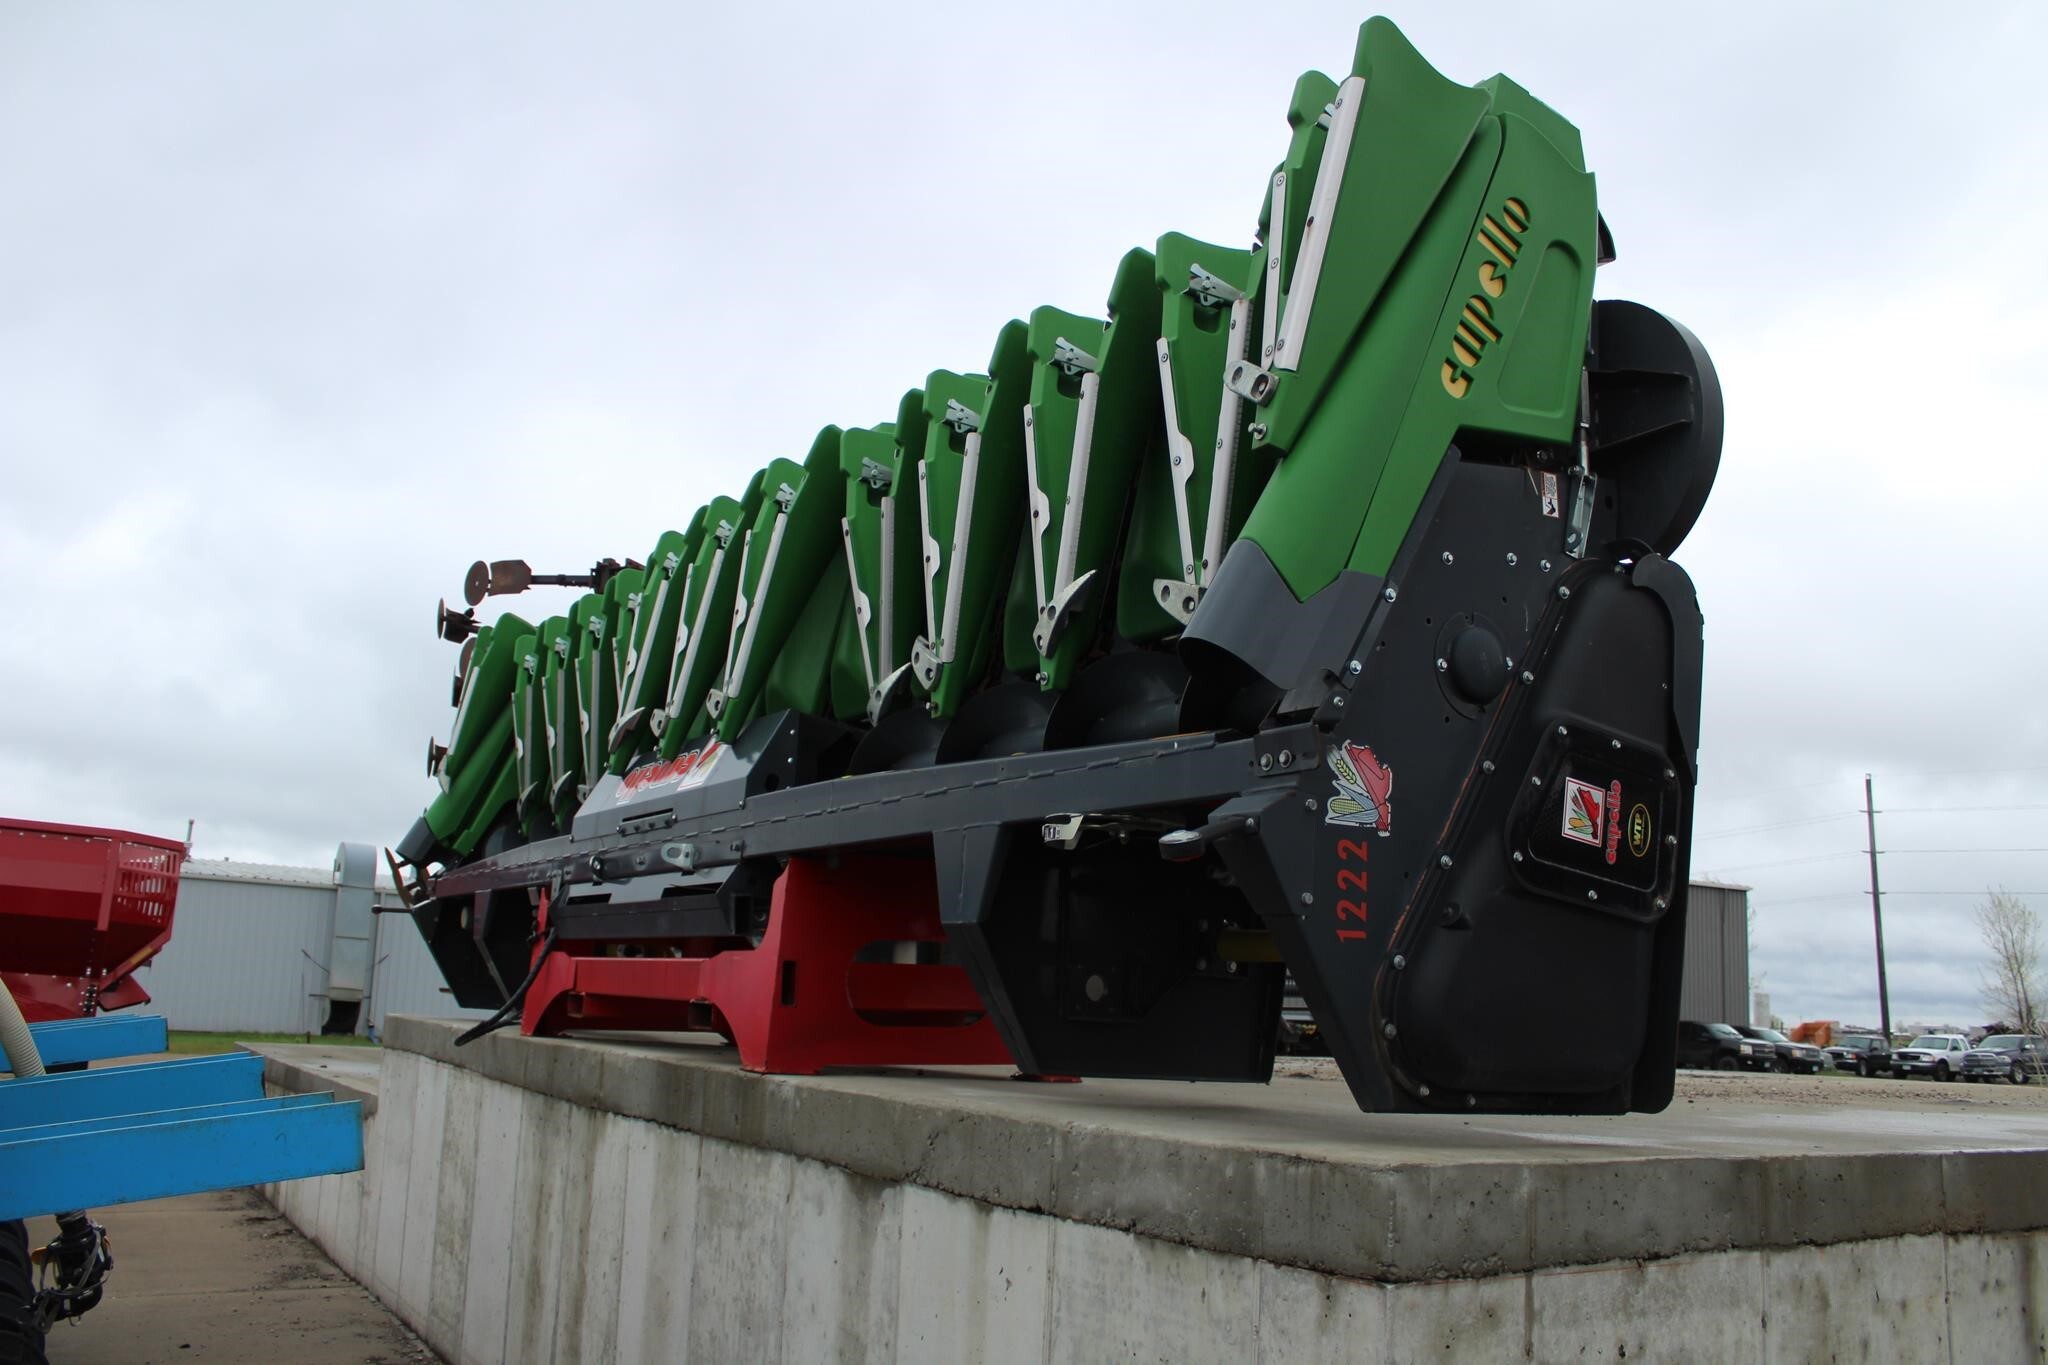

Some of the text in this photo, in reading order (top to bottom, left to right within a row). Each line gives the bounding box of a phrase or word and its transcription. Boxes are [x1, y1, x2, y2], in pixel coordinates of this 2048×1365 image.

[1441, 197, 1530, 399] capello
[1633, 812, 1642, 846] WTP
[1336, 838, 1368, 943] 1222
